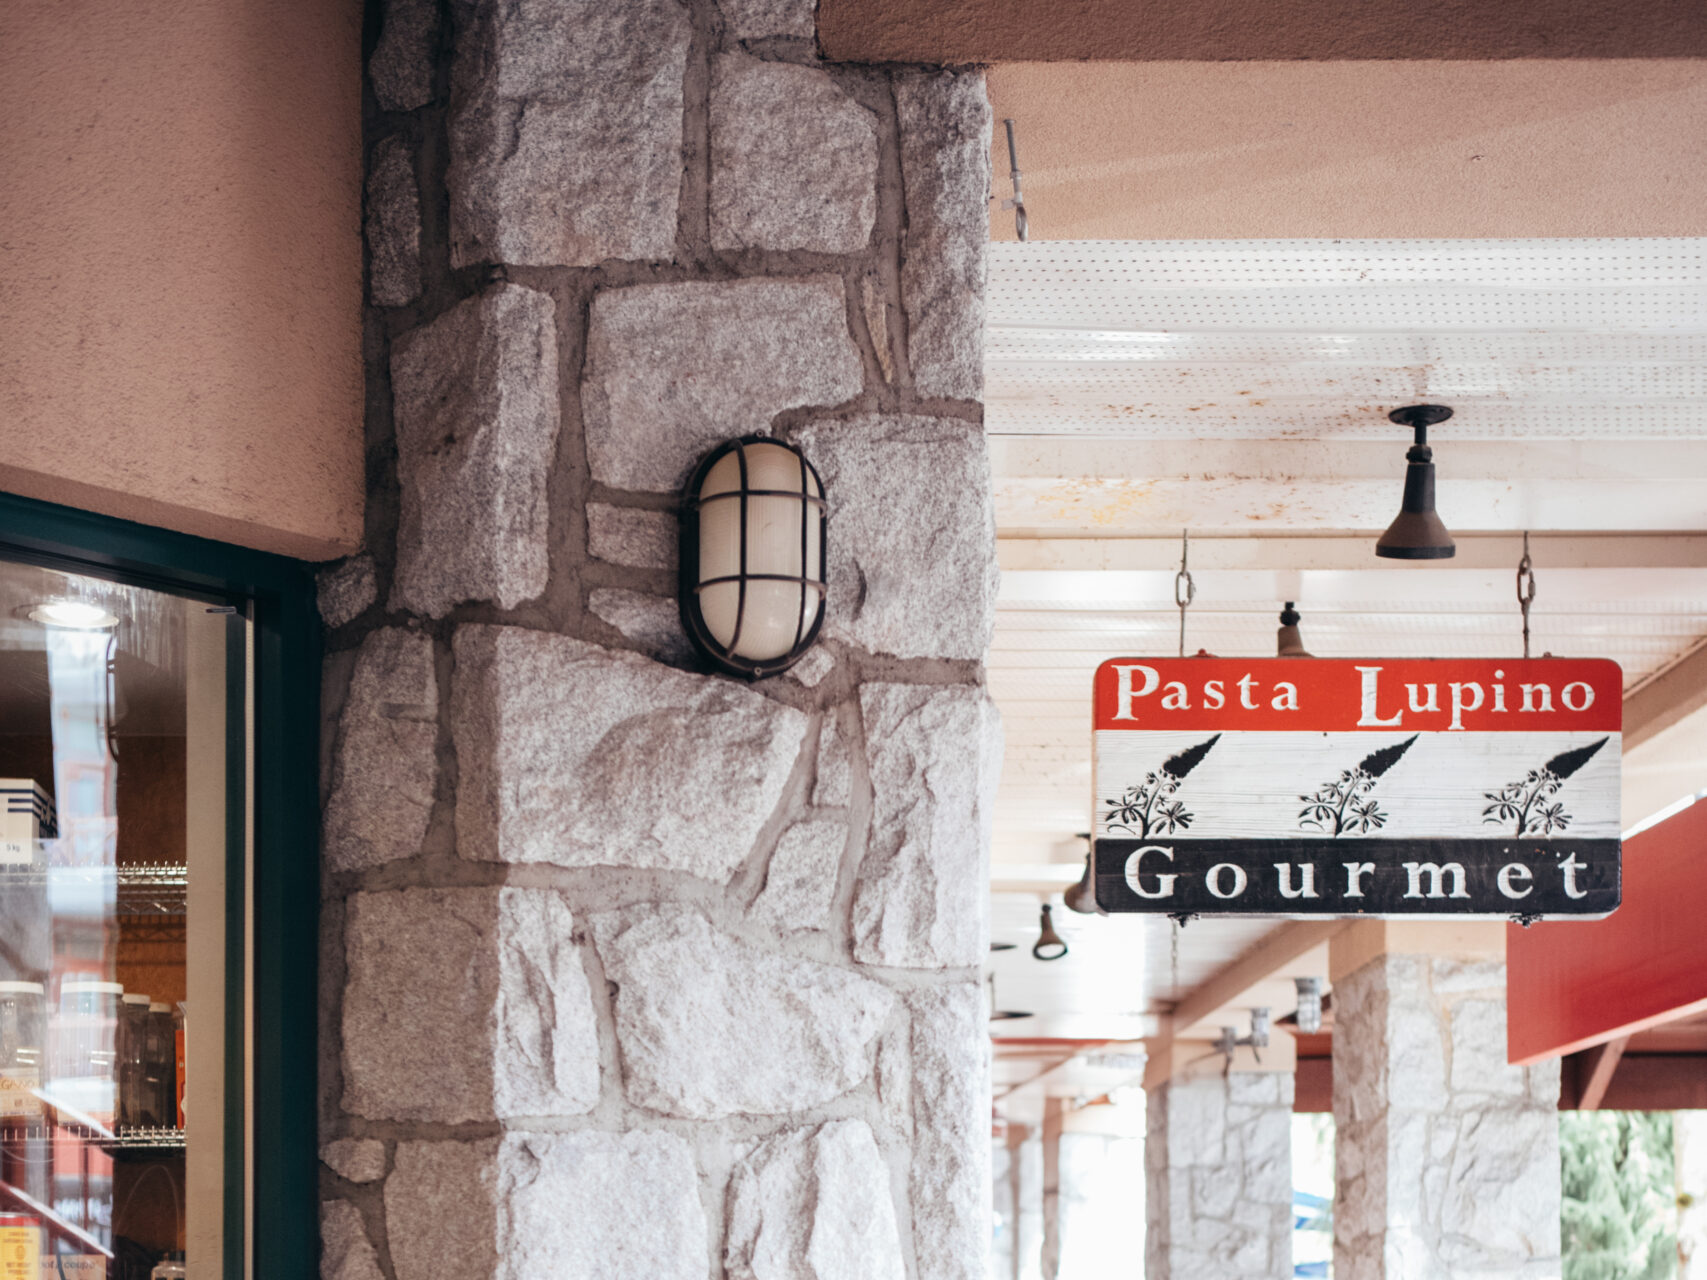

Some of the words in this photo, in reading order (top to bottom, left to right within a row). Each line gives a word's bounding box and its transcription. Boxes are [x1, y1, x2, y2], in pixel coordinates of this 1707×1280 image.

[1111, 664, 1300, 721] Pasta
[1354, 665, 1597, 731] Lupino
[1123, 845, 1589, 900] Gourmet
